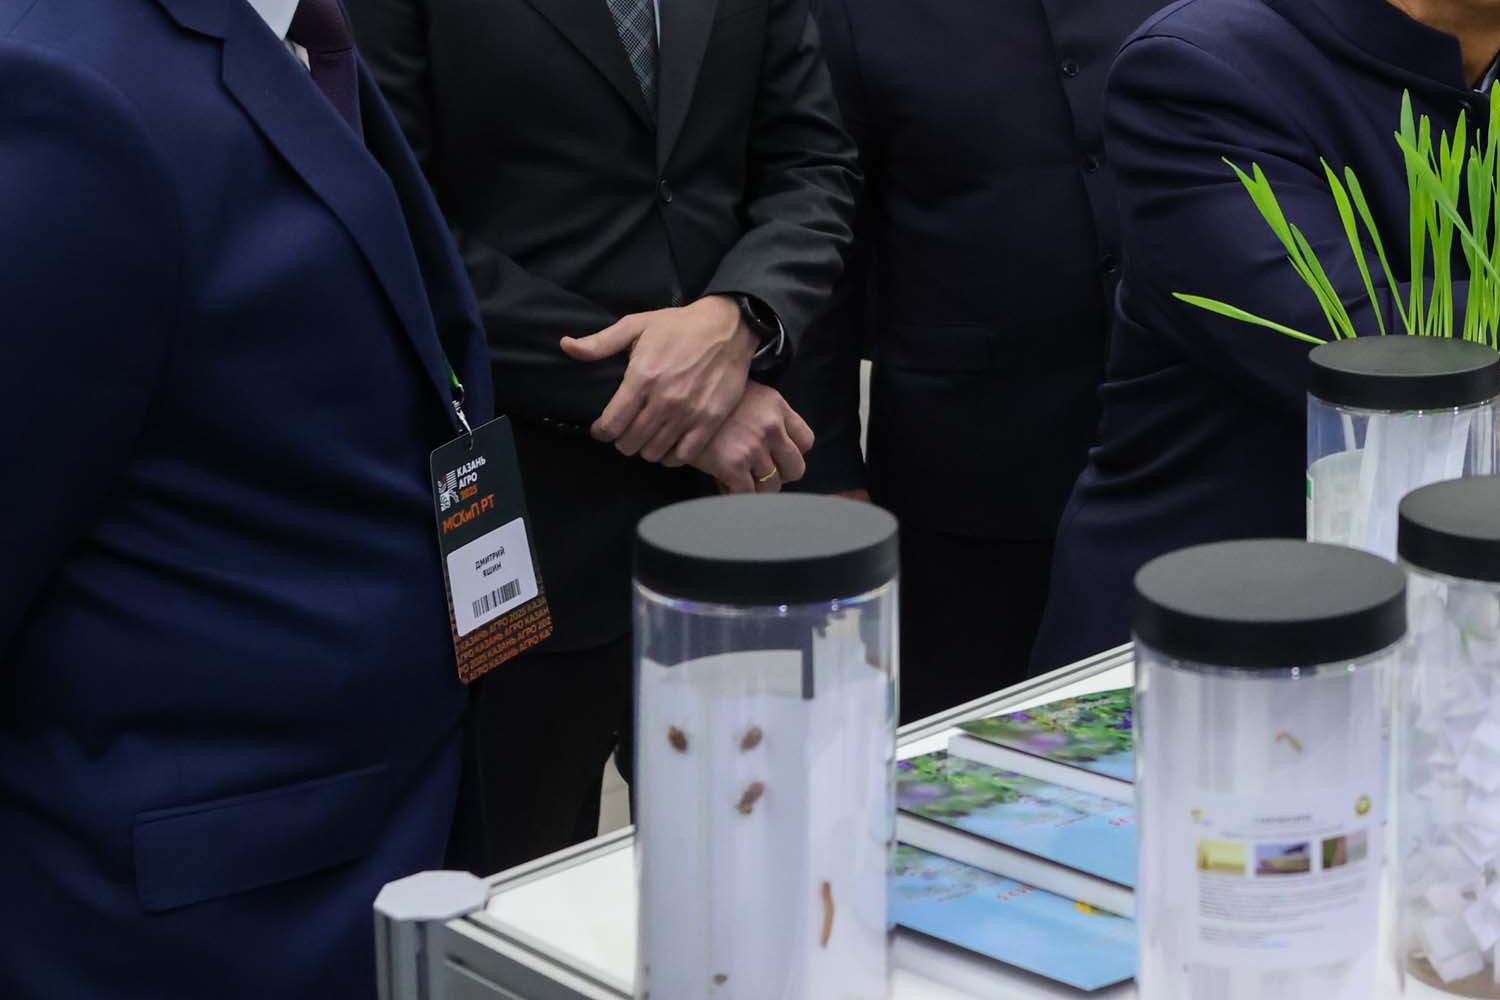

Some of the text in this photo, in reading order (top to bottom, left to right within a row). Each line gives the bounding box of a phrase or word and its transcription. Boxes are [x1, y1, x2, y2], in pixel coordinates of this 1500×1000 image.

[456, 456, 487, 478] КАЗАНЬ
[458, 472, 478, 490] АГРО
[480, 494, 496, 513] РТ
[475, 546, 505, 570] ДМИТРИЙ
[482, 561, 502, 577] ЯШИН
